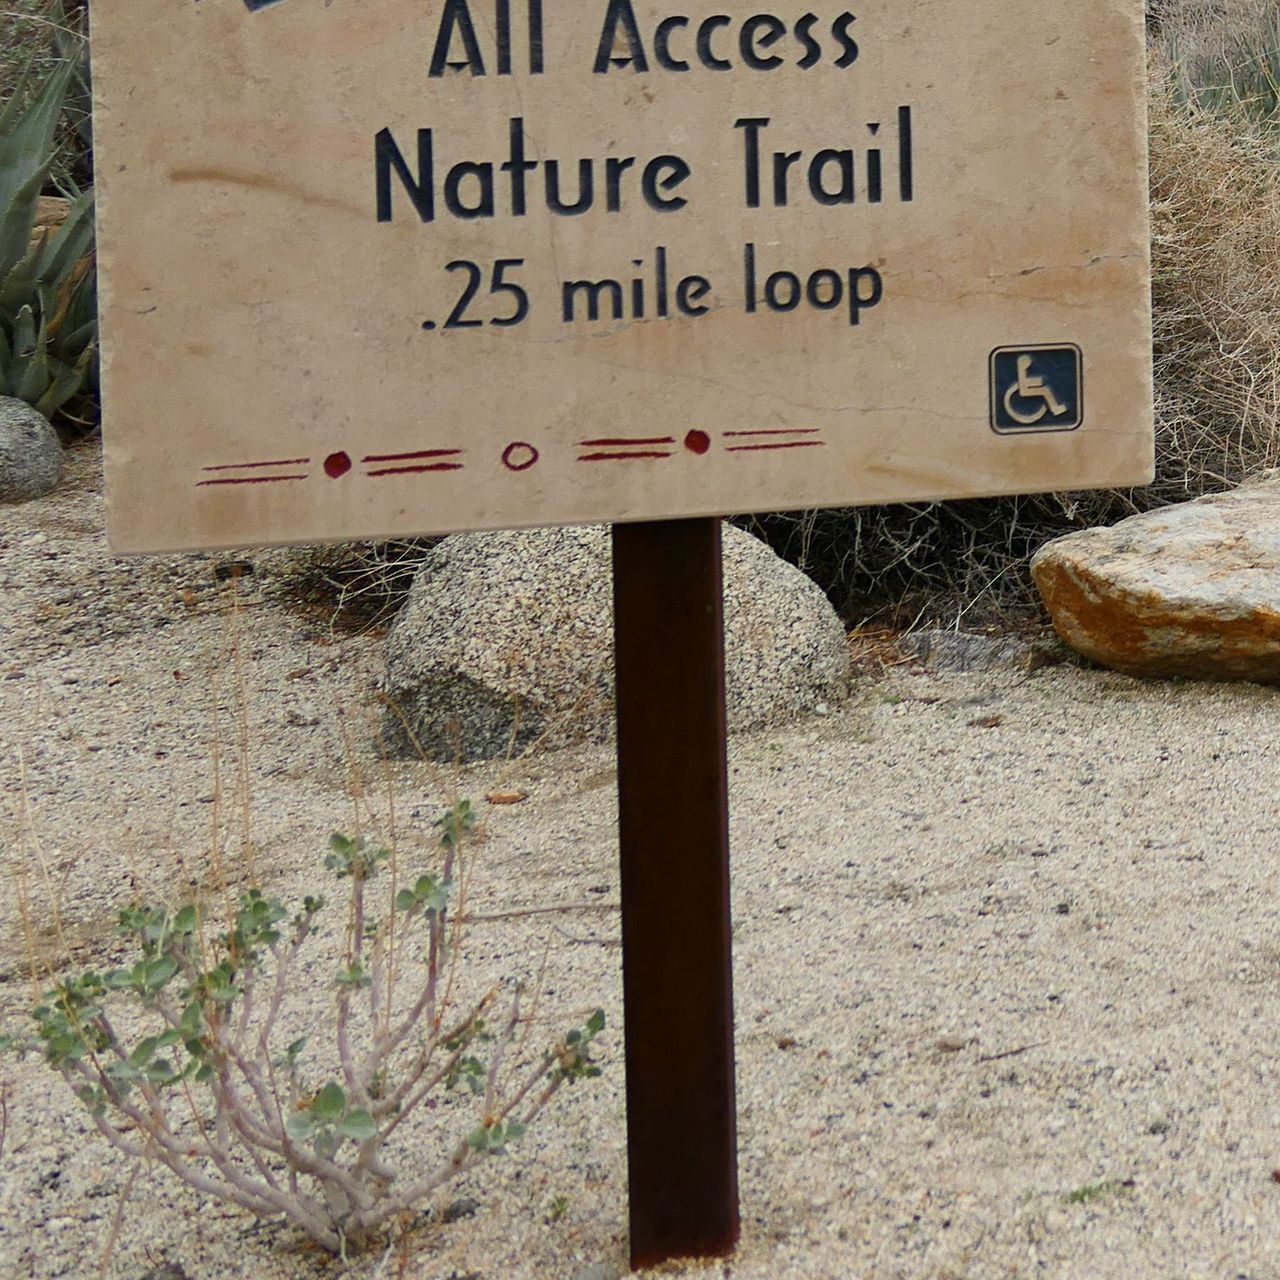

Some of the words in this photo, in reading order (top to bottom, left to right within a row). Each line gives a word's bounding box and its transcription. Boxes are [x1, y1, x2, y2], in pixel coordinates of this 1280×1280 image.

[374, 116, 692, 224] Nature
[733, 105, 913, 209] Trail
[421, 258, 530, 331] .25
[561, 245, 712, 323] mile
[743, 242, 884, 327] loop
